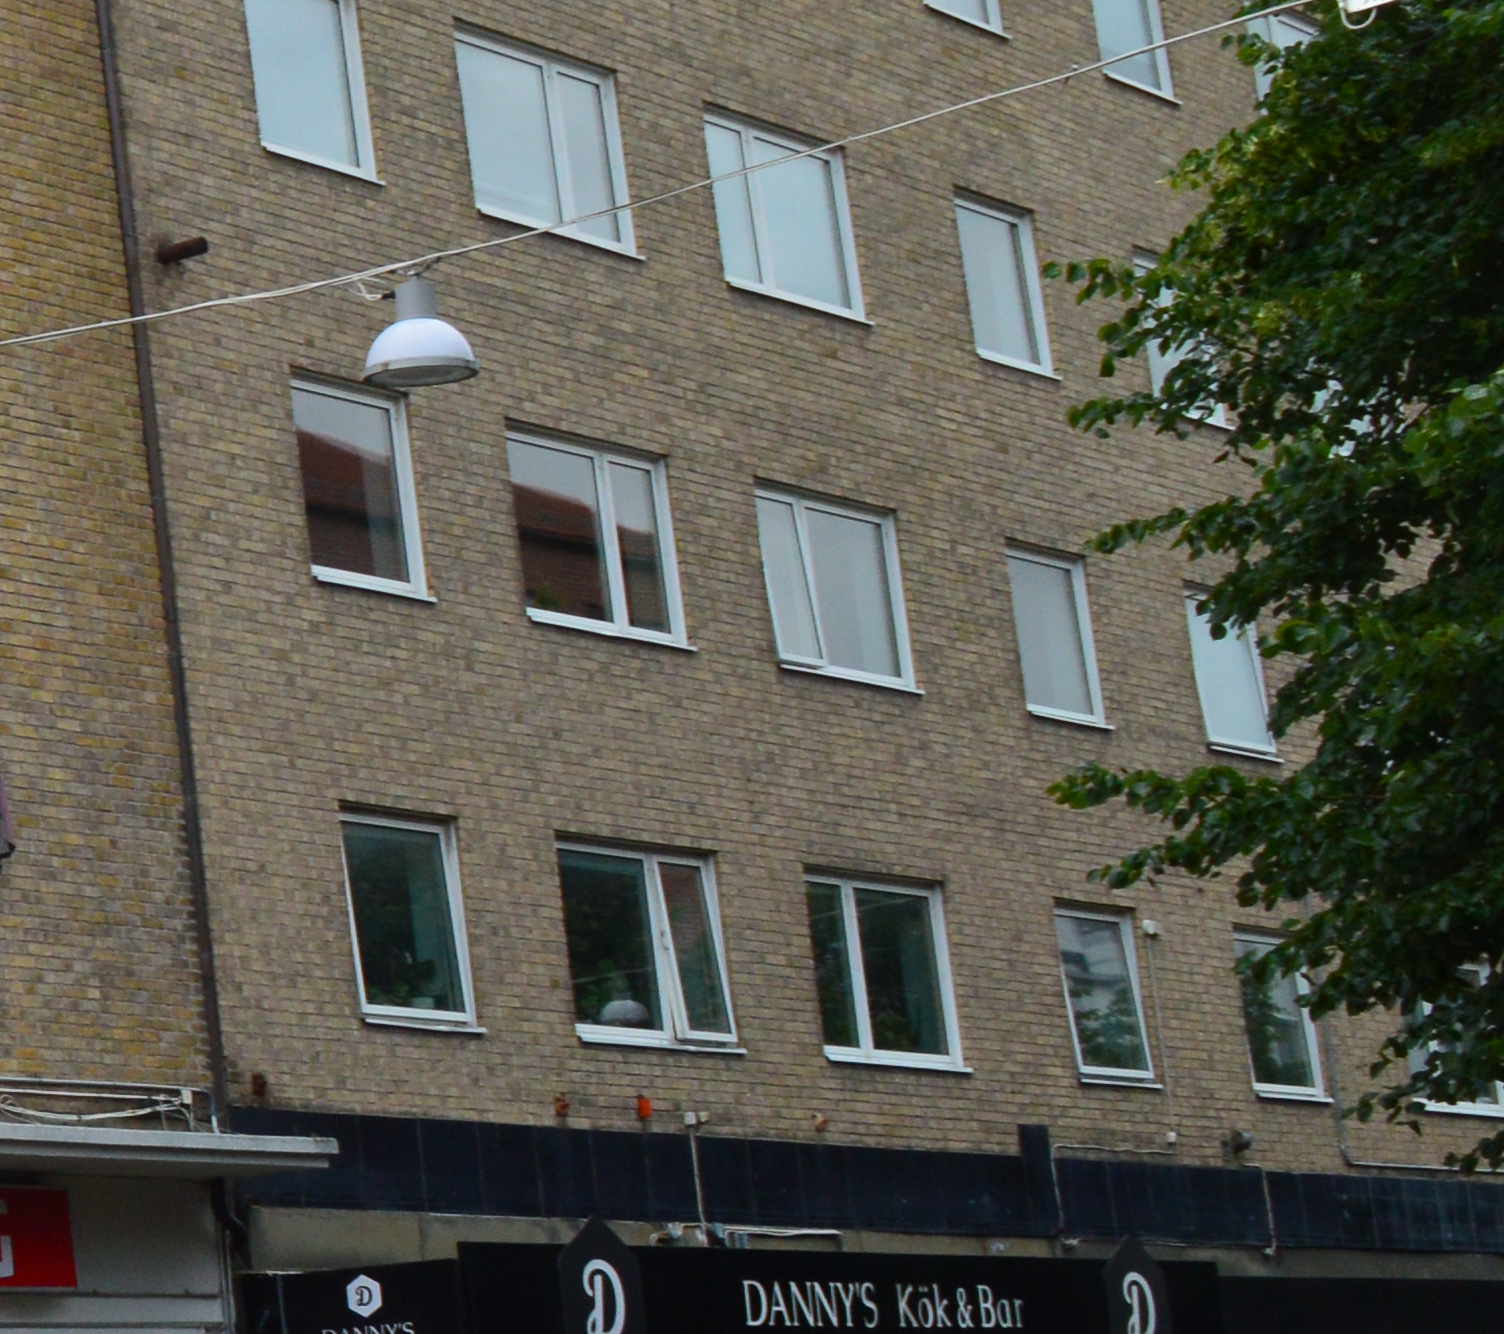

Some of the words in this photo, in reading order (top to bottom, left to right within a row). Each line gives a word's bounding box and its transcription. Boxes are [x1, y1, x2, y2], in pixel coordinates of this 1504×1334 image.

[355, 1285, 373, 1307] D
[743, 1279, 880, 1329] DANNY'S
[896, 1283, 951, 1329] Kök
[956, 1289, 974, 1329] &
[979, 1284, 1024, 1329] Bar
